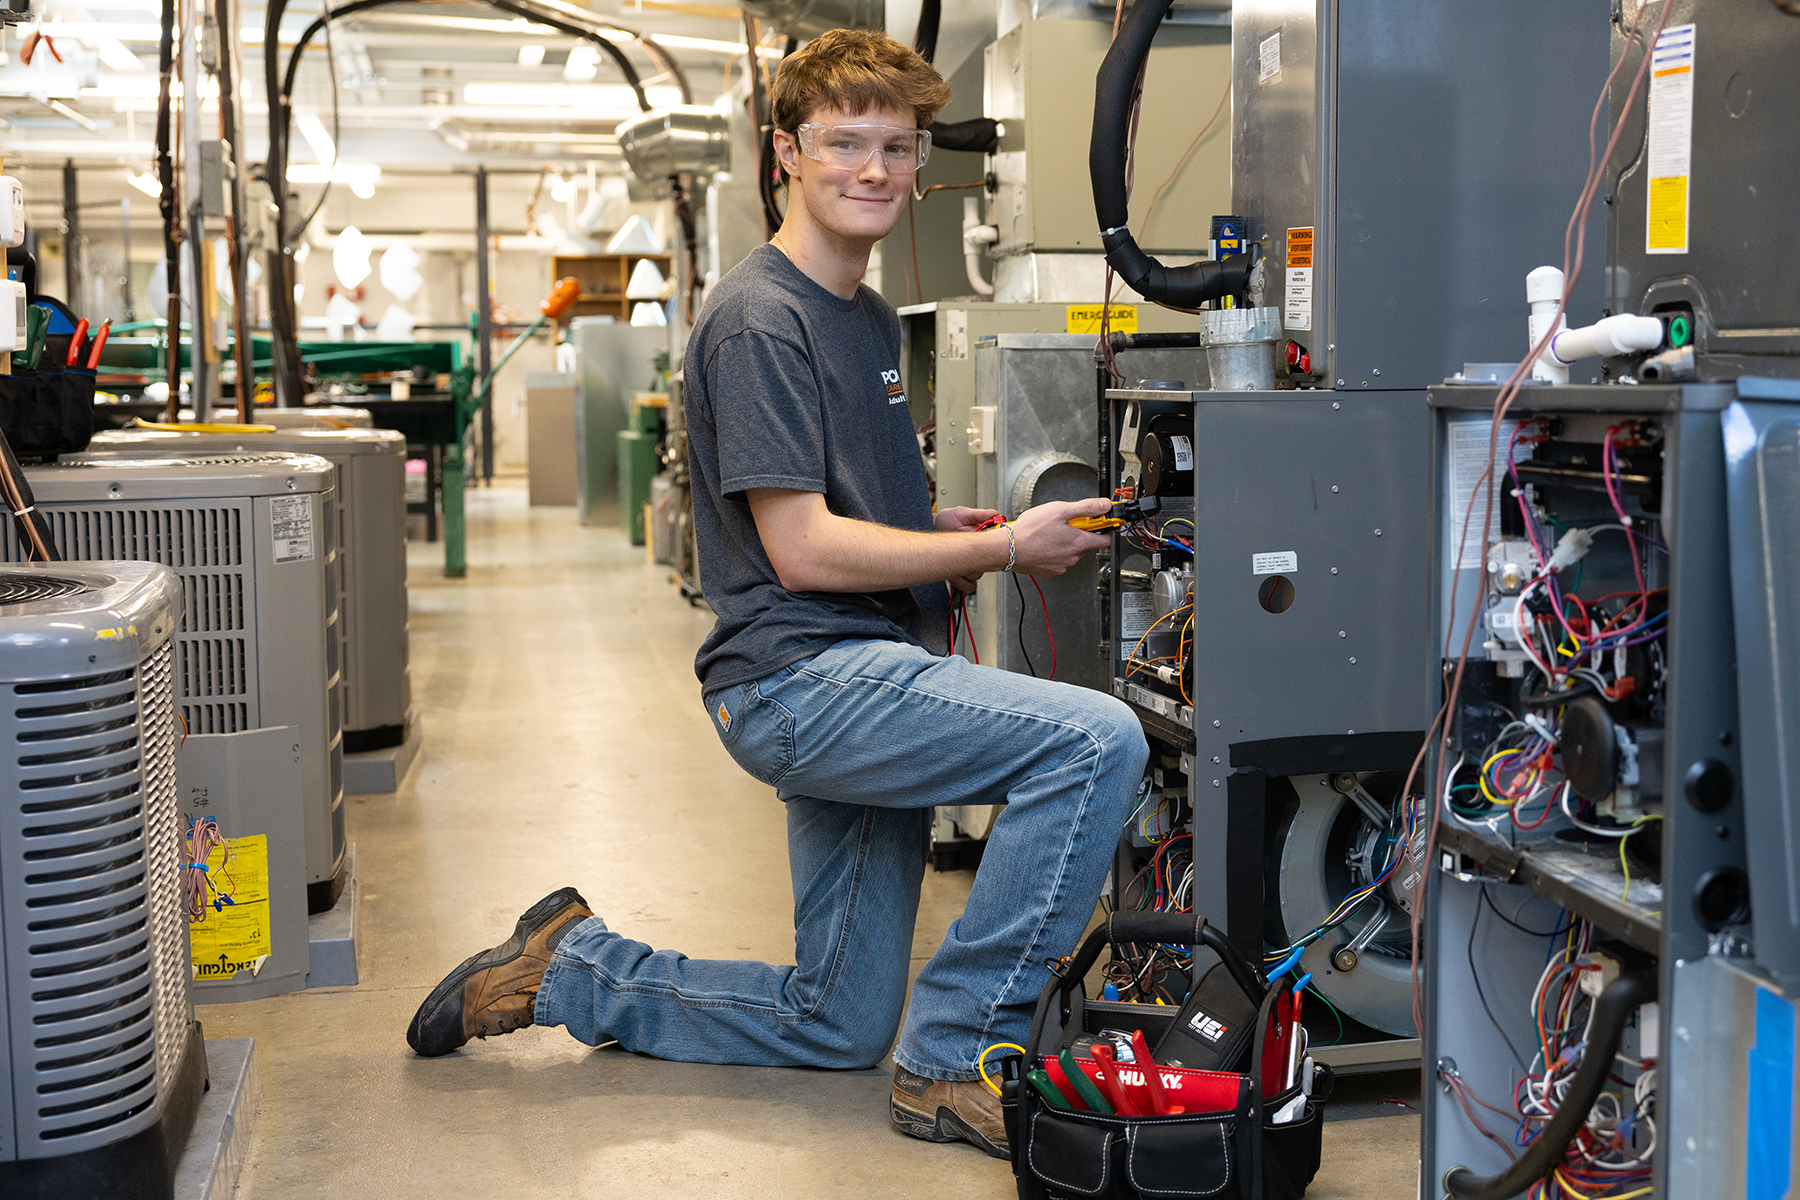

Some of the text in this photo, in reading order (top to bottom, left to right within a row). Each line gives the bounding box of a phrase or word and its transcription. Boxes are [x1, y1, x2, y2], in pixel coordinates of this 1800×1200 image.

[1291, 231, 1312, 239] WARNING
[193, 797, 209, 808] #5
[1119, 1070, 1183, 1089] HUKY
